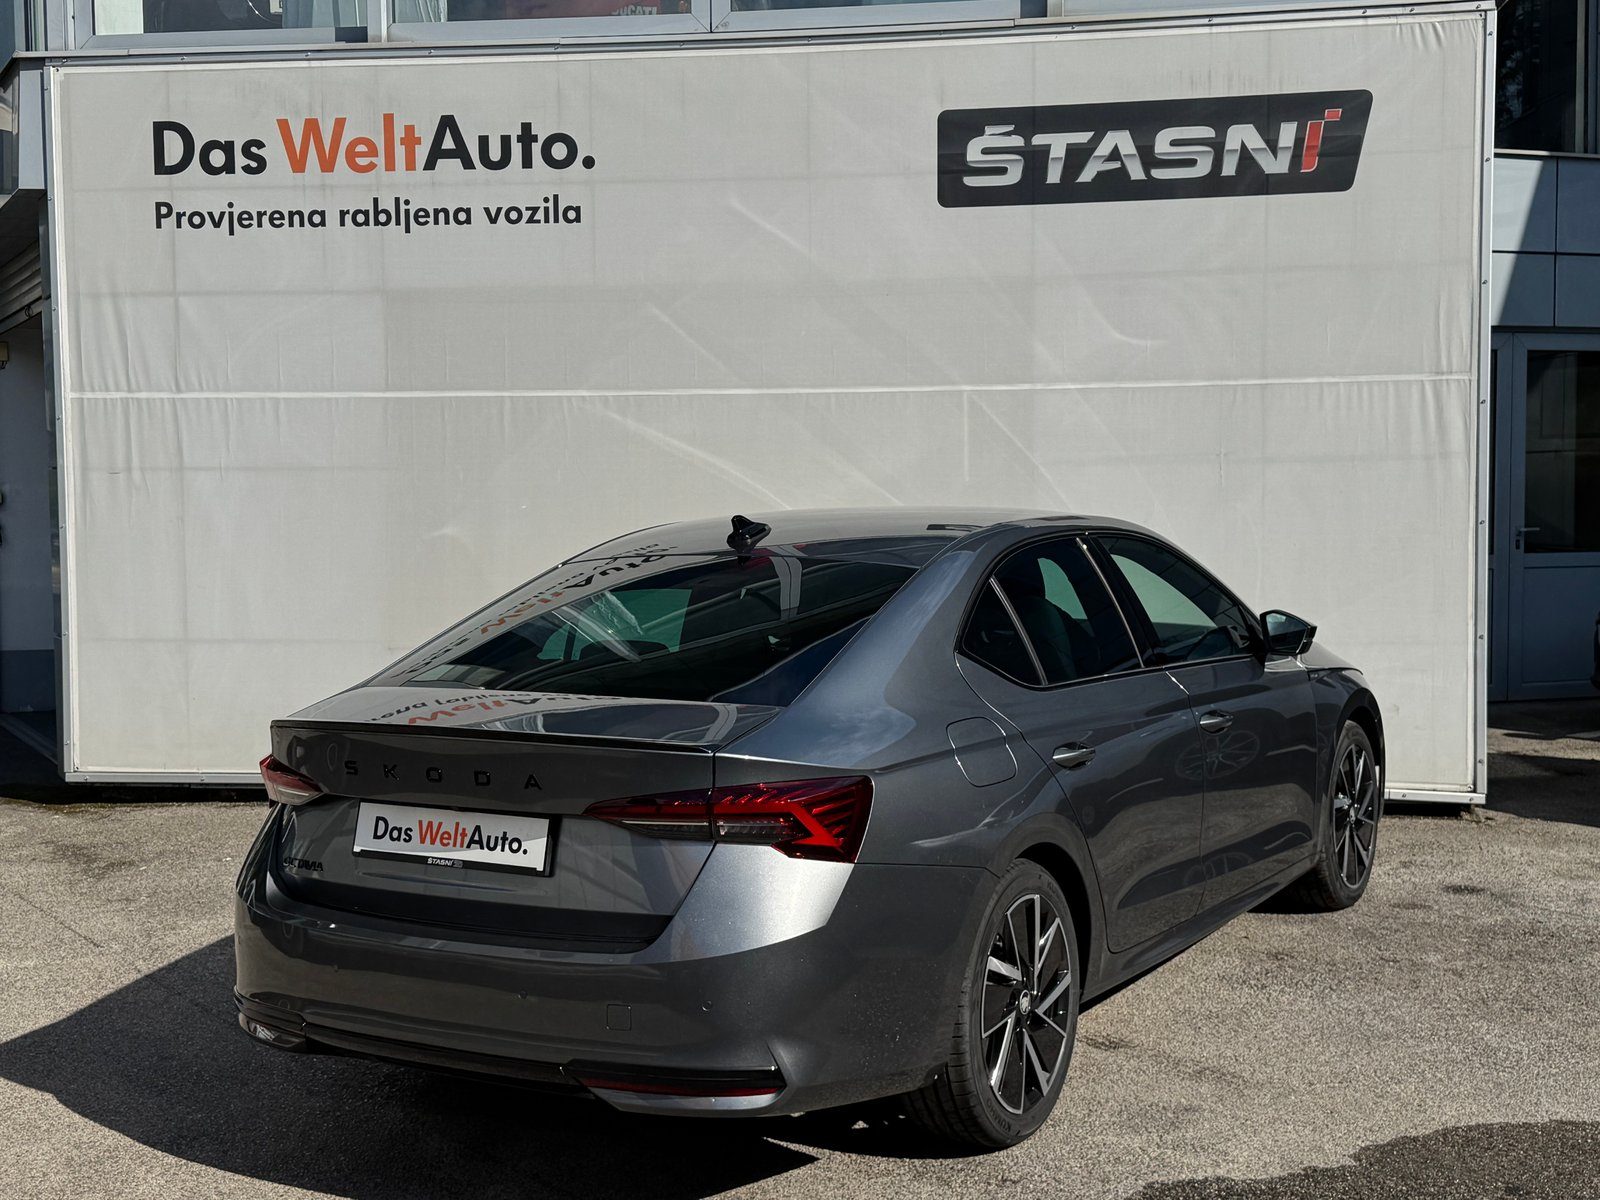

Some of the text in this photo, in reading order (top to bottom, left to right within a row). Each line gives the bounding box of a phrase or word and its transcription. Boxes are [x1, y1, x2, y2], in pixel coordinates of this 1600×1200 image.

[152, 112, 596, 176] Das WeltAuto.
[154, 193, 582, 237] Provjerena rabljena vozila
[344, 760, 542, 791] SKODA
[372, 815, 528, 855] Das WeltAuto.
